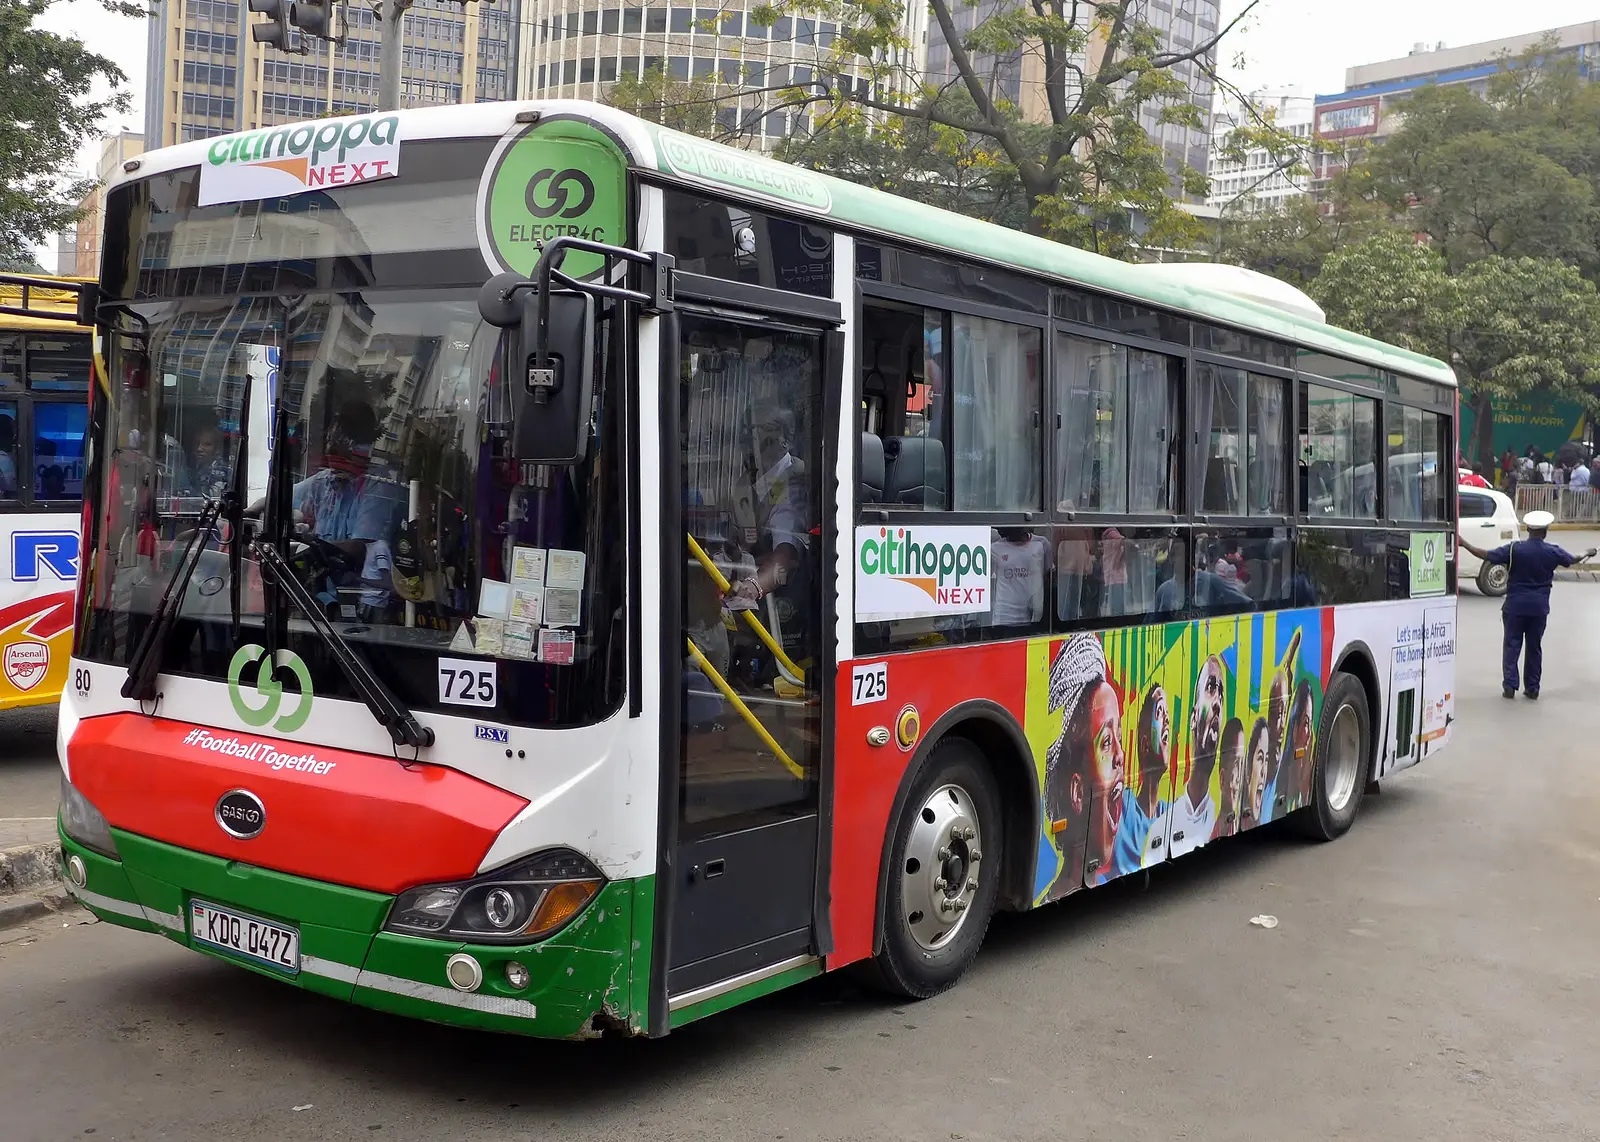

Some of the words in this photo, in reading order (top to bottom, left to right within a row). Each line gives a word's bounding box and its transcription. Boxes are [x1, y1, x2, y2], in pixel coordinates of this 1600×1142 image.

[208, 116, 399, 166] citihoppa
[308, 160, 389, 187] NEXT
[1529, 416, 1565, 427] WORK
[860, 527, 987, 587] citihoppa
[937, 588, 985, 605] NEXT
[1396, 626, 1411, 643] Let's
[1412, 624, 1429, 640] make
[1430, 623, 1446, 638] Africa
[11, 650, 43, 659] Arsenal
[1396, 648, 1406, 663] the
[1407, 647, 1424, 661] home
[1427, 643, 1433, 659] of
[1433, 640, 1454, 658] football
[75, 668, 91, 691] 80
[440, 668, 494, 702] 725
[854, 671, 886, 700] 725
[477, 726, 506, 742] P.S.V.
[183, 728, 337, 775] #FootballTogether
[222, 805, 260, 824] BASIGO
[208, 910, 241, 949] KDQ
[248, 922, 292, 965] 047Z
